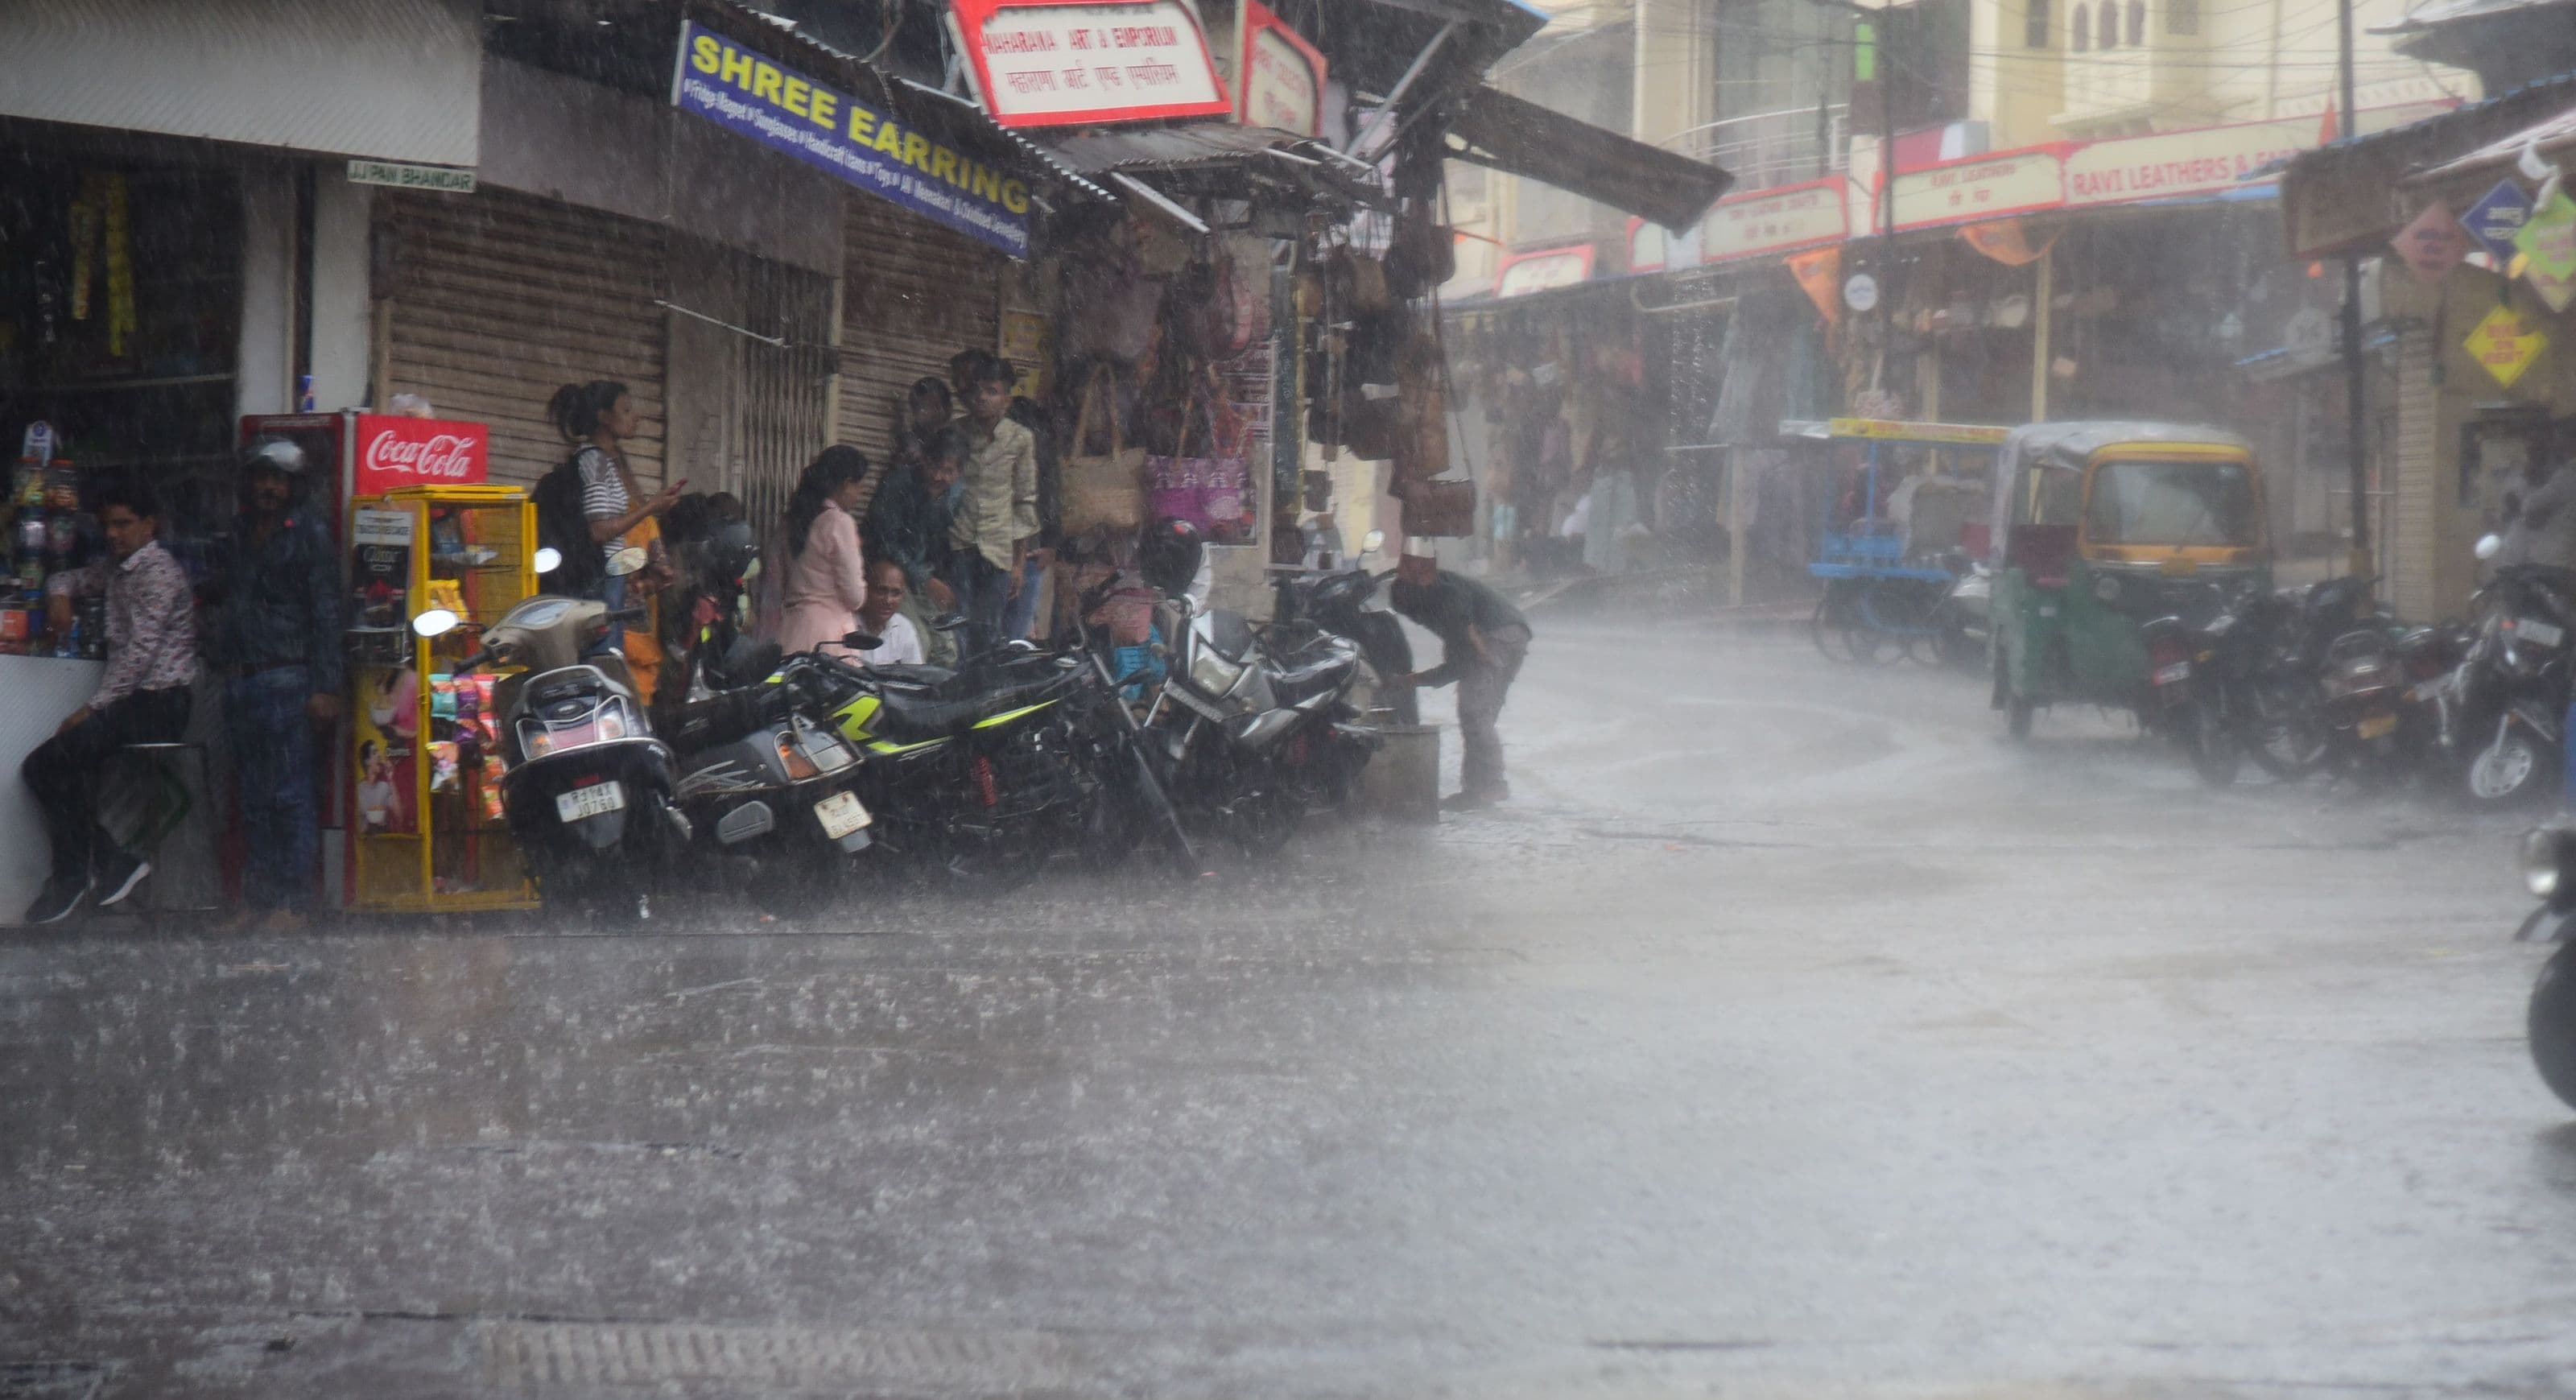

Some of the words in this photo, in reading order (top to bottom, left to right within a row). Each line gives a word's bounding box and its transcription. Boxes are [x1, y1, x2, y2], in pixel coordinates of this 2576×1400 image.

[980, 31, 1058, 55] MAHARANA
[1069, 28, 1091, 50] ART
[1111, 26, 1179, 48] EMPORIUM
[691, 35, 838, 130] SHREE
[848, 105, 1029, 213] EARRING
[370, 164, 398, 183] PAN
[402, 167, 472, 190] BHANDAR
[2073, 167, 2123, 196] RAVI
[2128, 155, 2229, 190] LEATHERS
[366, 430, 477, 477] Coca-Cola
